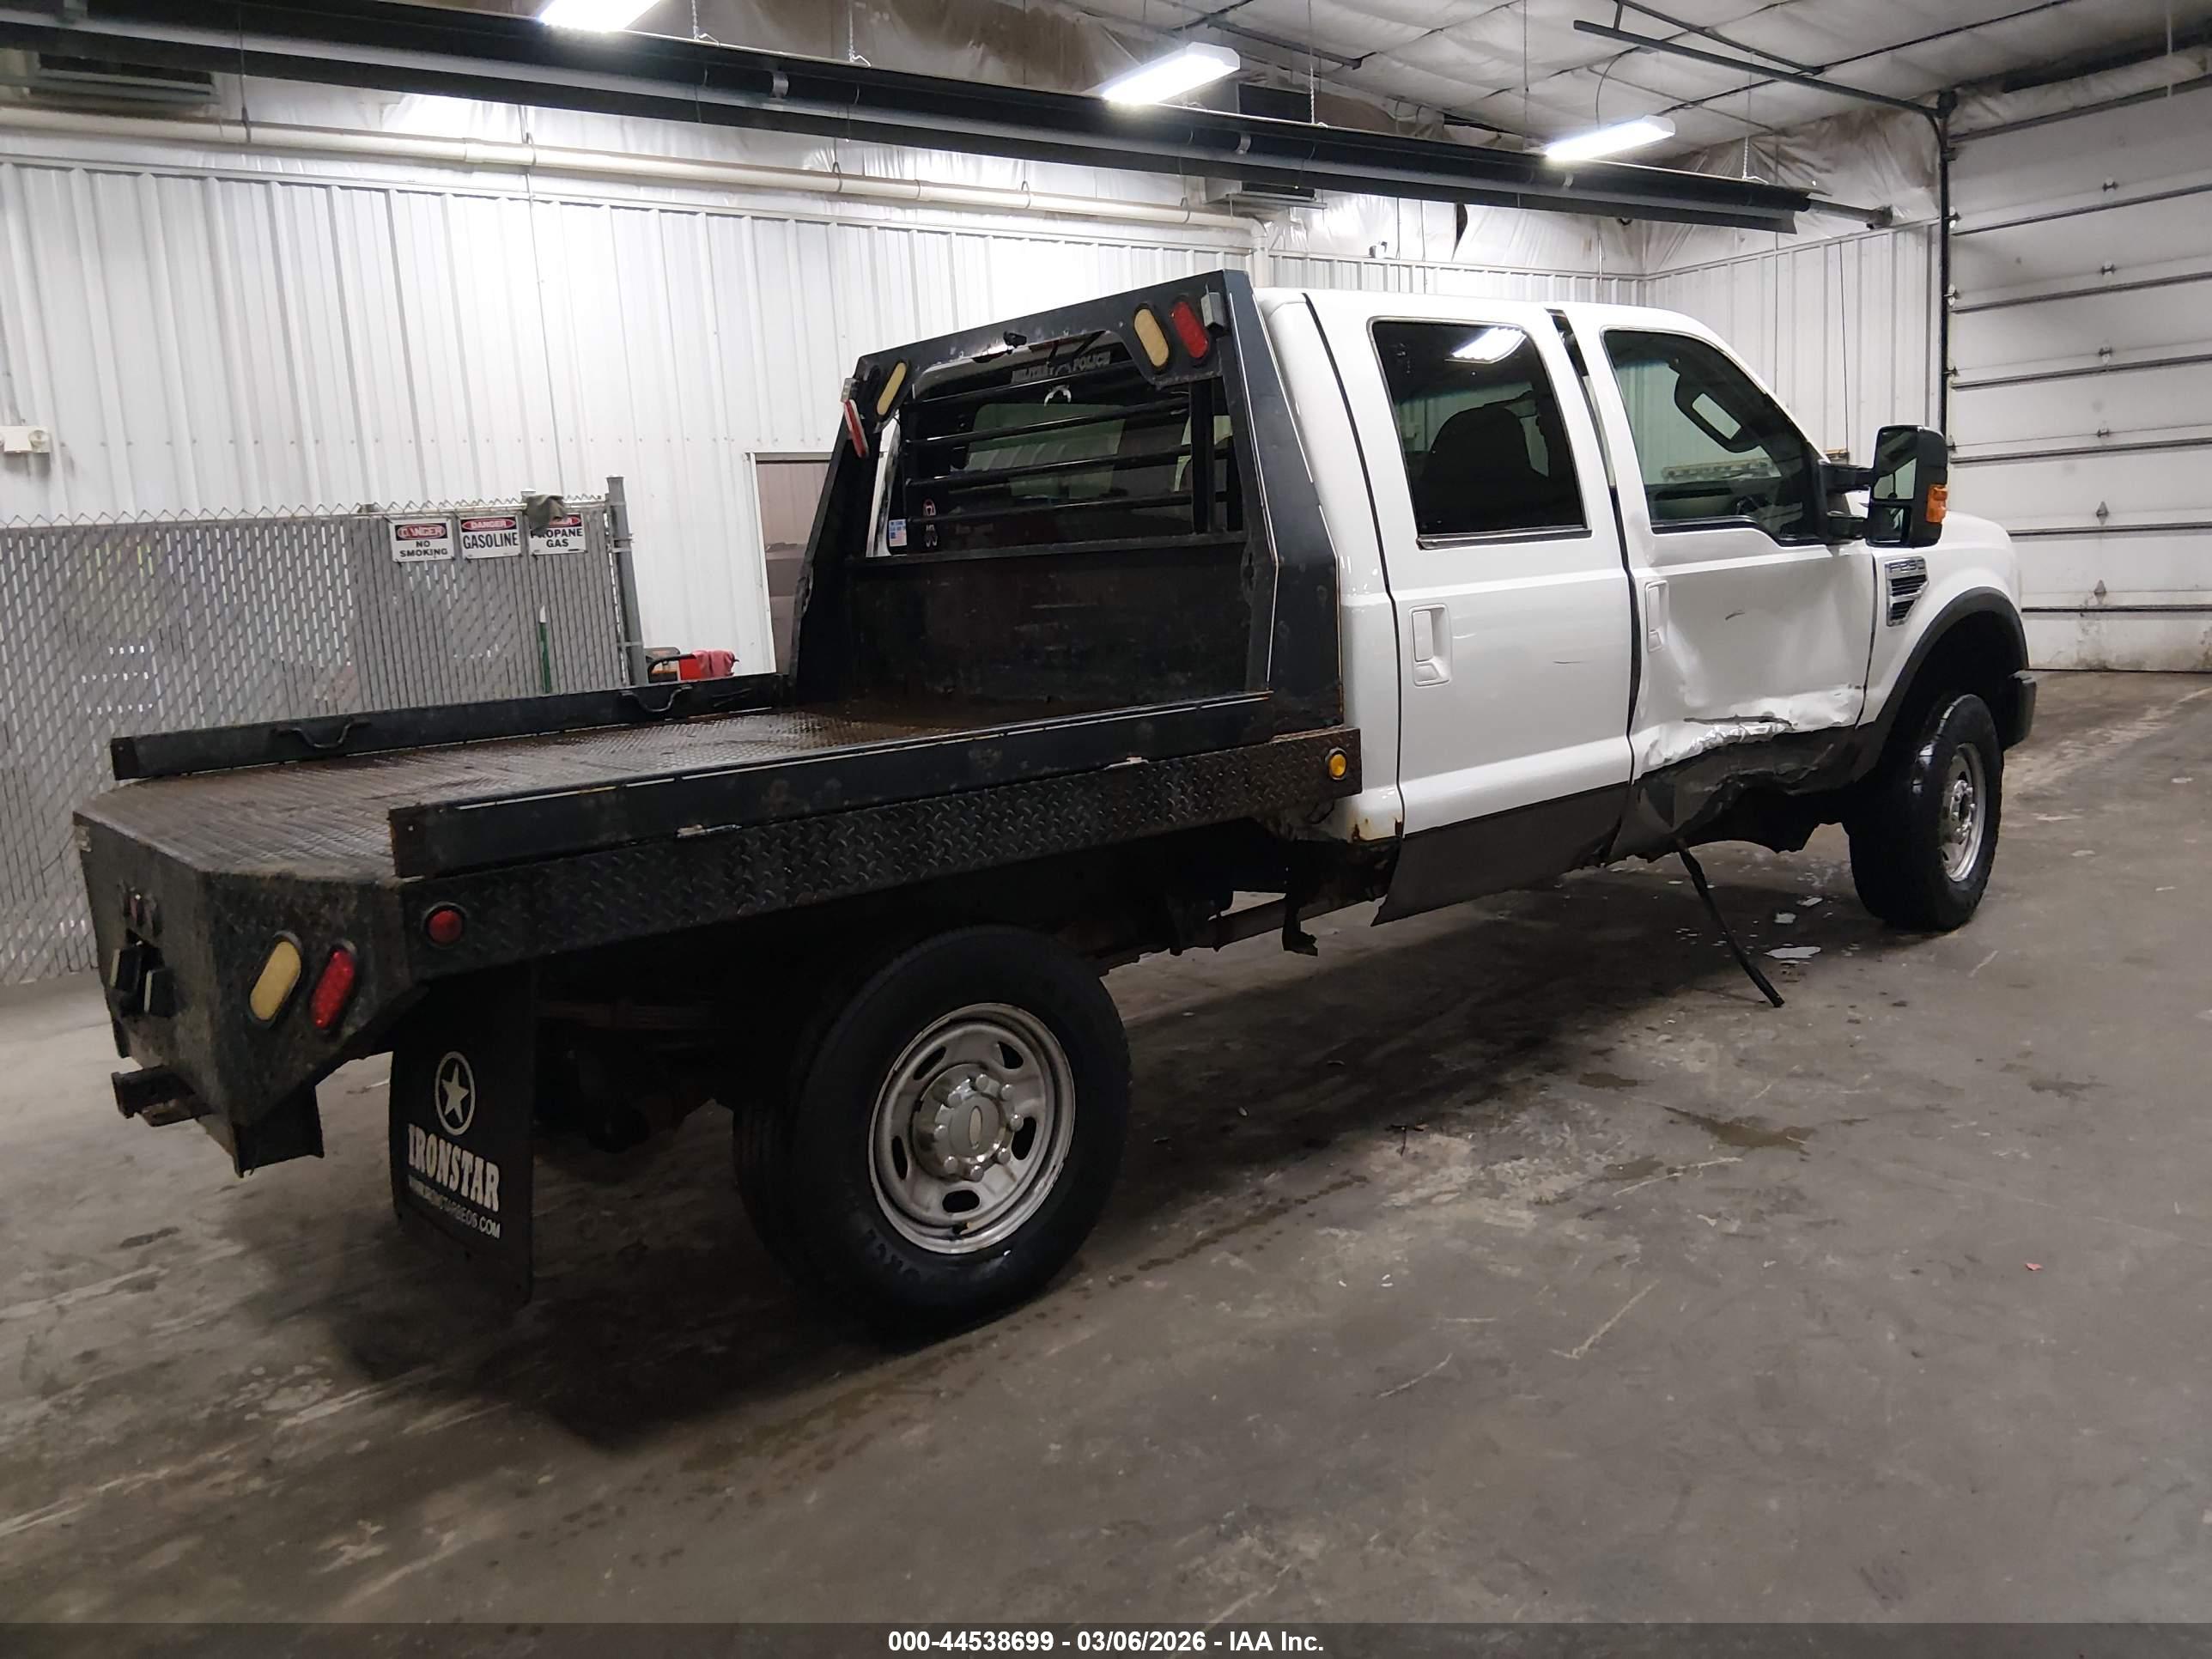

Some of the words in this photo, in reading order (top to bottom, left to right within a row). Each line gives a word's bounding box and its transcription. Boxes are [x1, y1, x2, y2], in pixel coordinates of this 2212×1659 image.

[471, 520, 507, 529] DANGER
[530, 528, 583, 538] POPANE
[463, 532, 519, 549] GASOLINE
[546, 538, 569, 548] GAS
[399, 548, 448, 557] SMOKING
[407, 1123, 500, 1213] IRONSTAR
